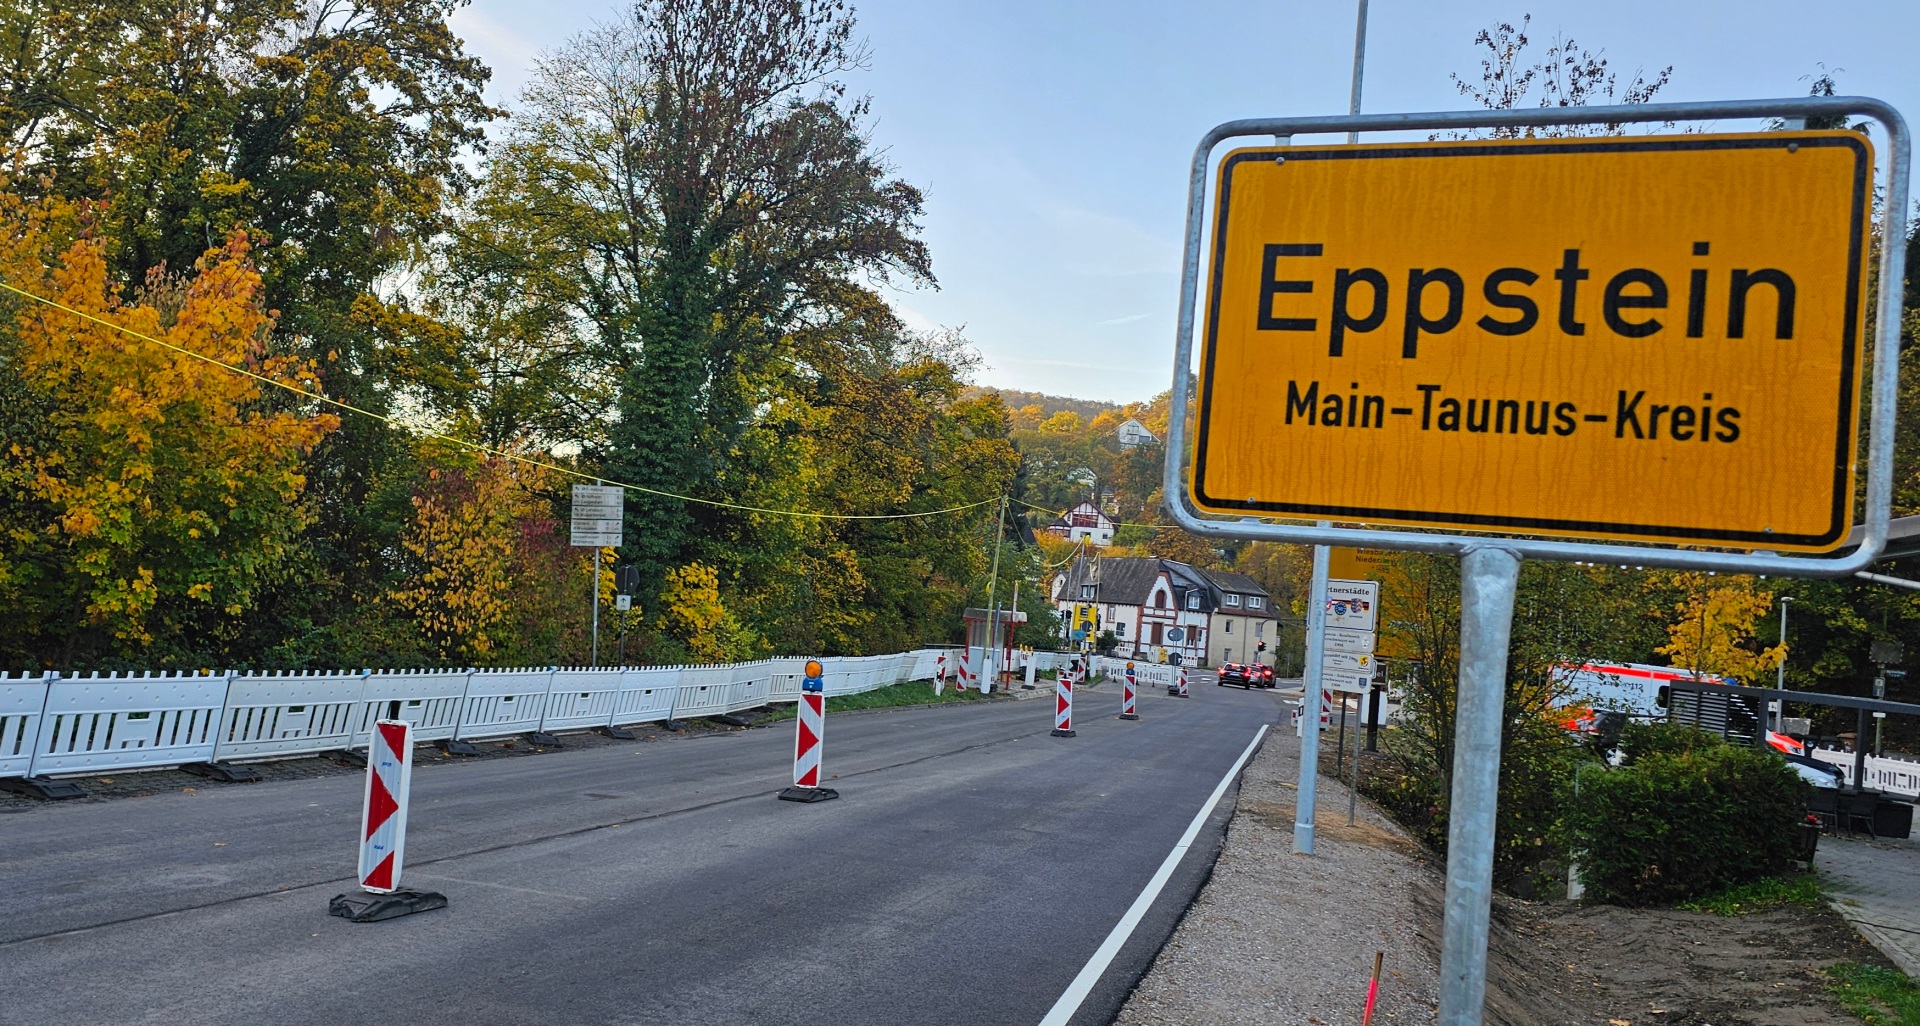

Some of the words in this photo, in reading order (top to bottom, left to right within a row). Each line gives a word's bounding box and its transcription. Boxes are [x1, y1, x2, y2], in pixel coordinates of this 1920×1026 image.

[1257, 242, 1796, 359] Eppstein
[1285, 380, 1741, 443] Main-Taunus-Kreis
[1327, 586, 1369, 596] rtnerstädte
